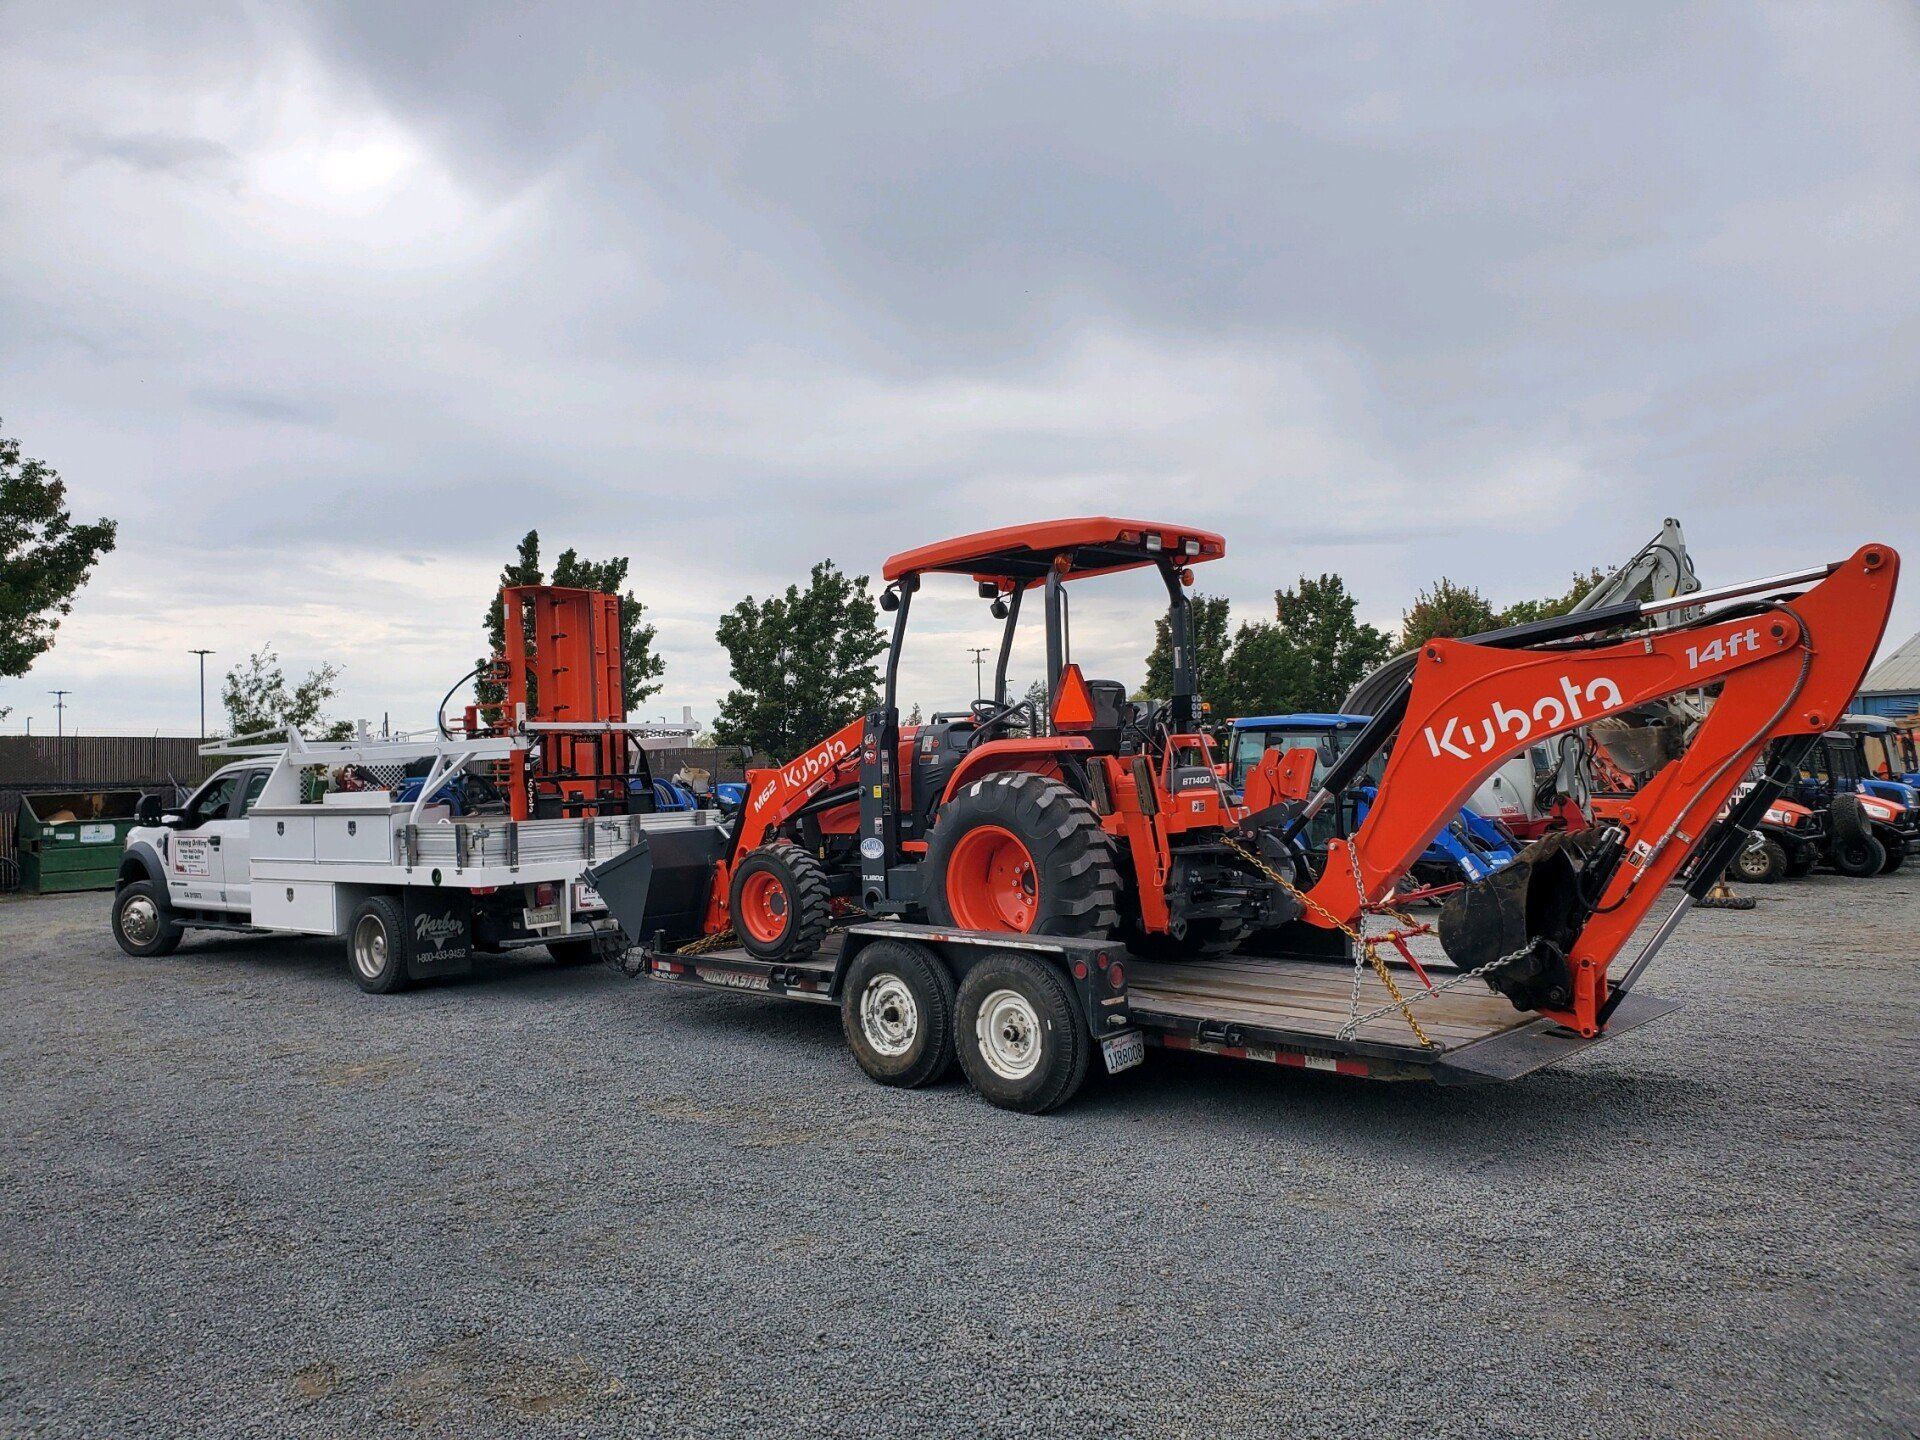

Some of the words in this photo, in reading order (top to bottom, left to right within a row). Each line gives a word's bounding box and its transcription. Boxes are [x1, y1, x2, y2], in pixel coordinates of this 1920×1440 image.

[1685, 628, 1760, 670] 14ft
[1423, 676, 1624, 760] Kubota
[783, 740, 847, 787] Kubota
[1182, 775, 1211, 786] BT1400
[527, 778, 535, 813] Kubota
[753, 779, 778, 814] M62
[192, 839, 208, 848] Drilling
[414, 910, 465, 940] Harbor
[1108, 1043, 1143, 1070] 1XB8008
